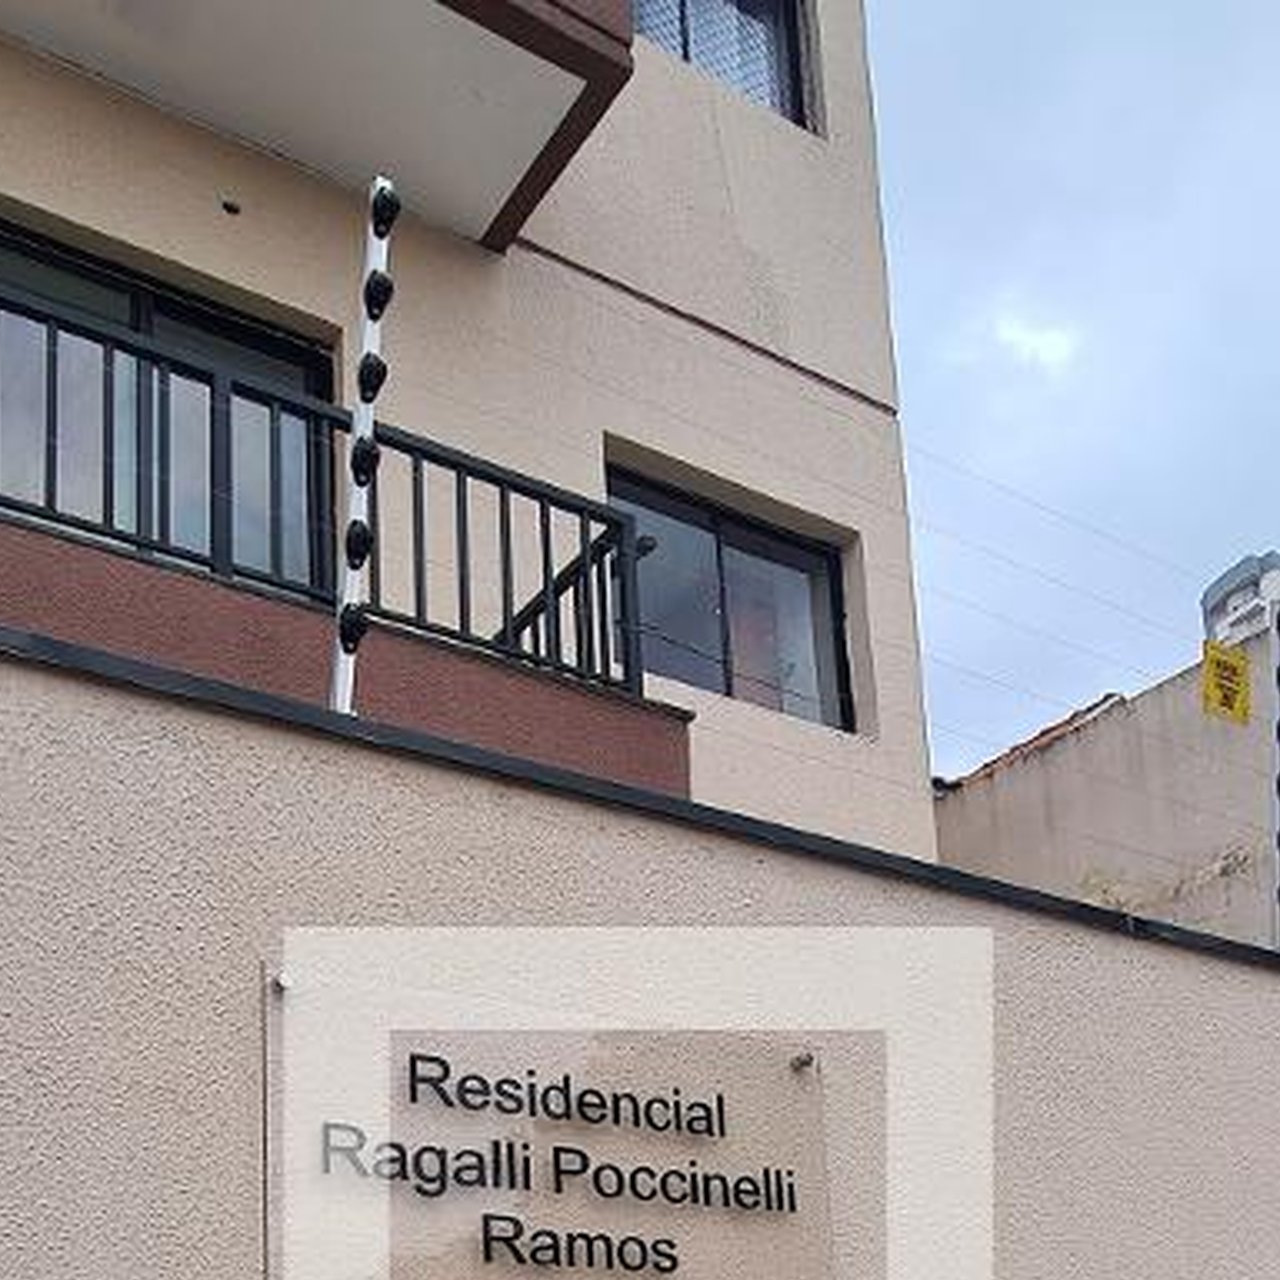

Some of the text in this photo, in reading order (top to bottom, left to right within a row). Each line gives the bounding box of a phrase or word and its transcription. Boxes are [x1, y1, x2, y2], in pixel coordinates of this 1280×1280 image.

[408, 1053, 726, 1138] Residencial
[321, 1122, 798, 1213] Ragalli Poccinelli
[481, 1214, 680, 1273] Ramos
